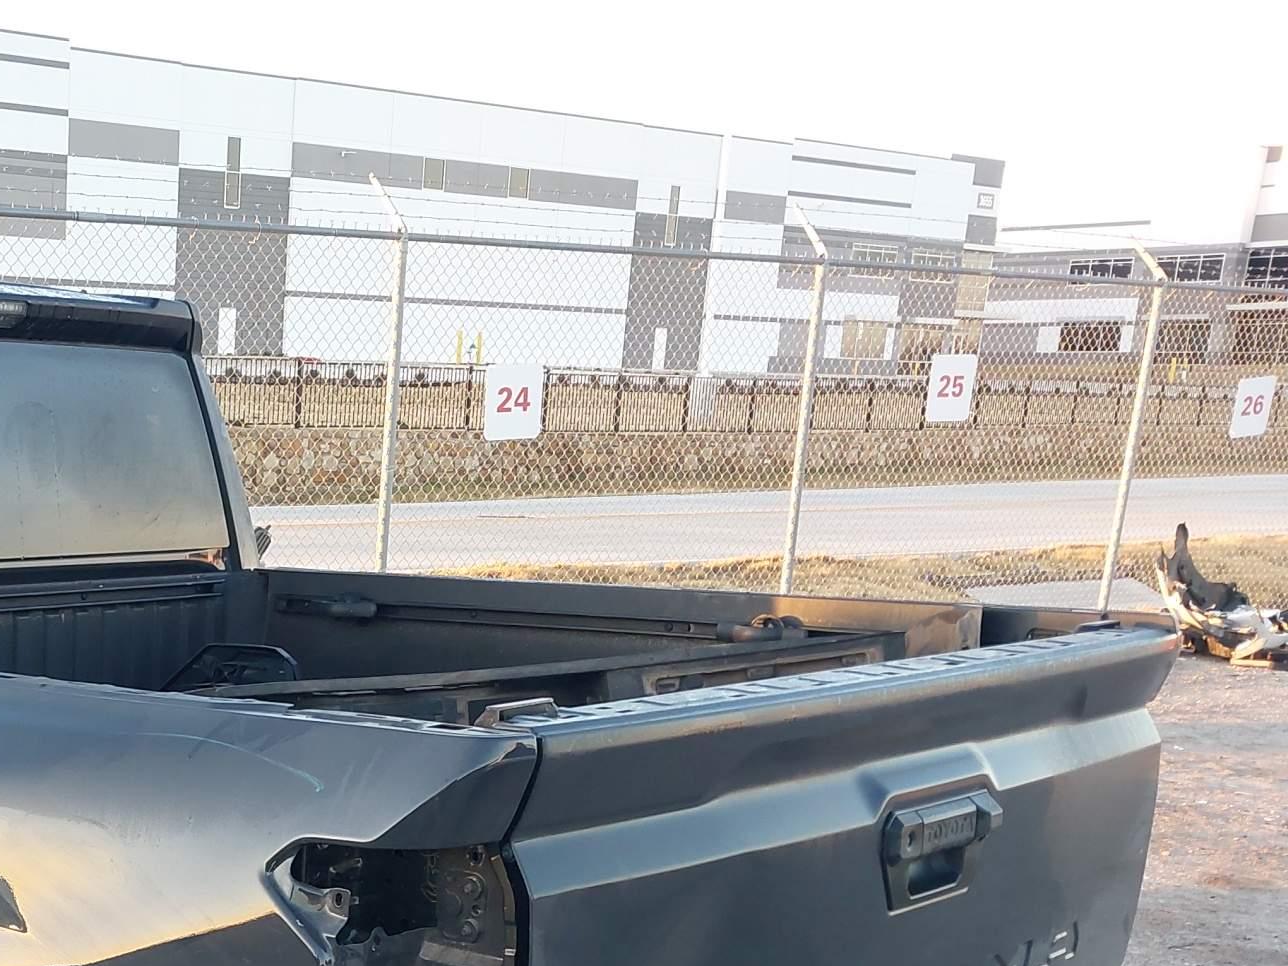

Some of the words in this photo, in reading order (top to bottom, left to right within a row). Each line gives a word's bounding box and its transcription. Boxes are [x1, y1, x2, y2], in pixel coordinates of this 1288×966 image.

[937, 375, 964, 398] 25
[496, 387, 531, 412] 24
[1241, 395, 1264, 416] 26
[924, 814, 974, 843] TOYOTA
